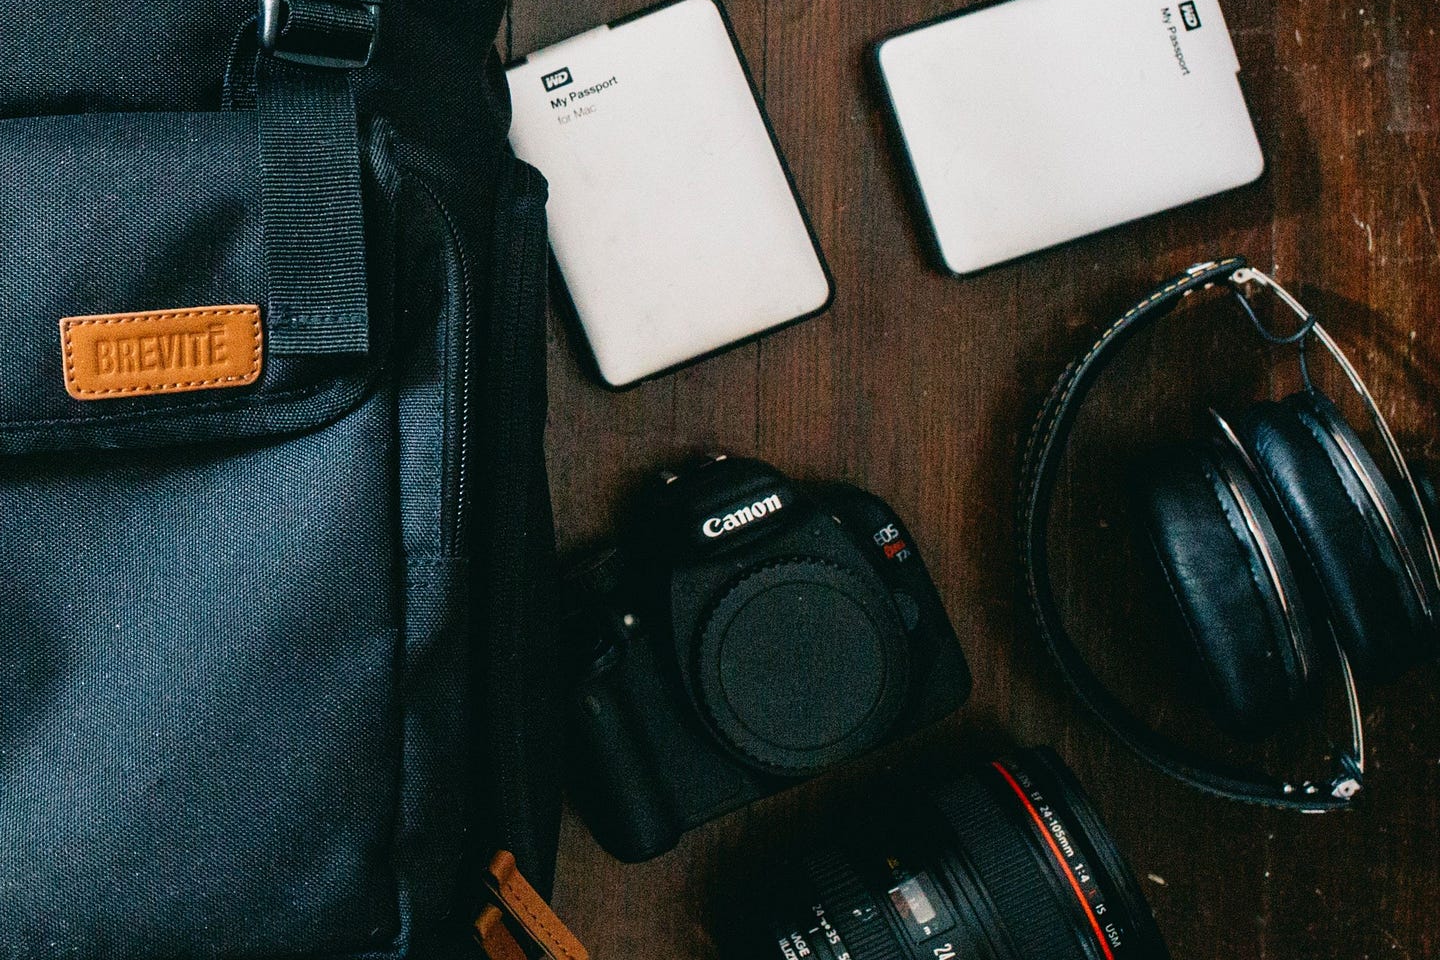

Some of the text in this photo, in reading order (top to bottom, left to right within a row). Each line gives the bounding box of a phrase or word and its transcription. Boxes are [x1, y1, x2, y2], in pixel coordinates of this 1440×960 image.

[1161, 7, 1190, 76] My Passport
[543, 68, 572, 91] WD
[550, 76, 618, 111] My Passport
[573, 104, 597, 119] Mac
[702, 494, 783, 538] Canon
[873, 523, 900, 546] EOS
[1104, 923, 1122, 949] USM
